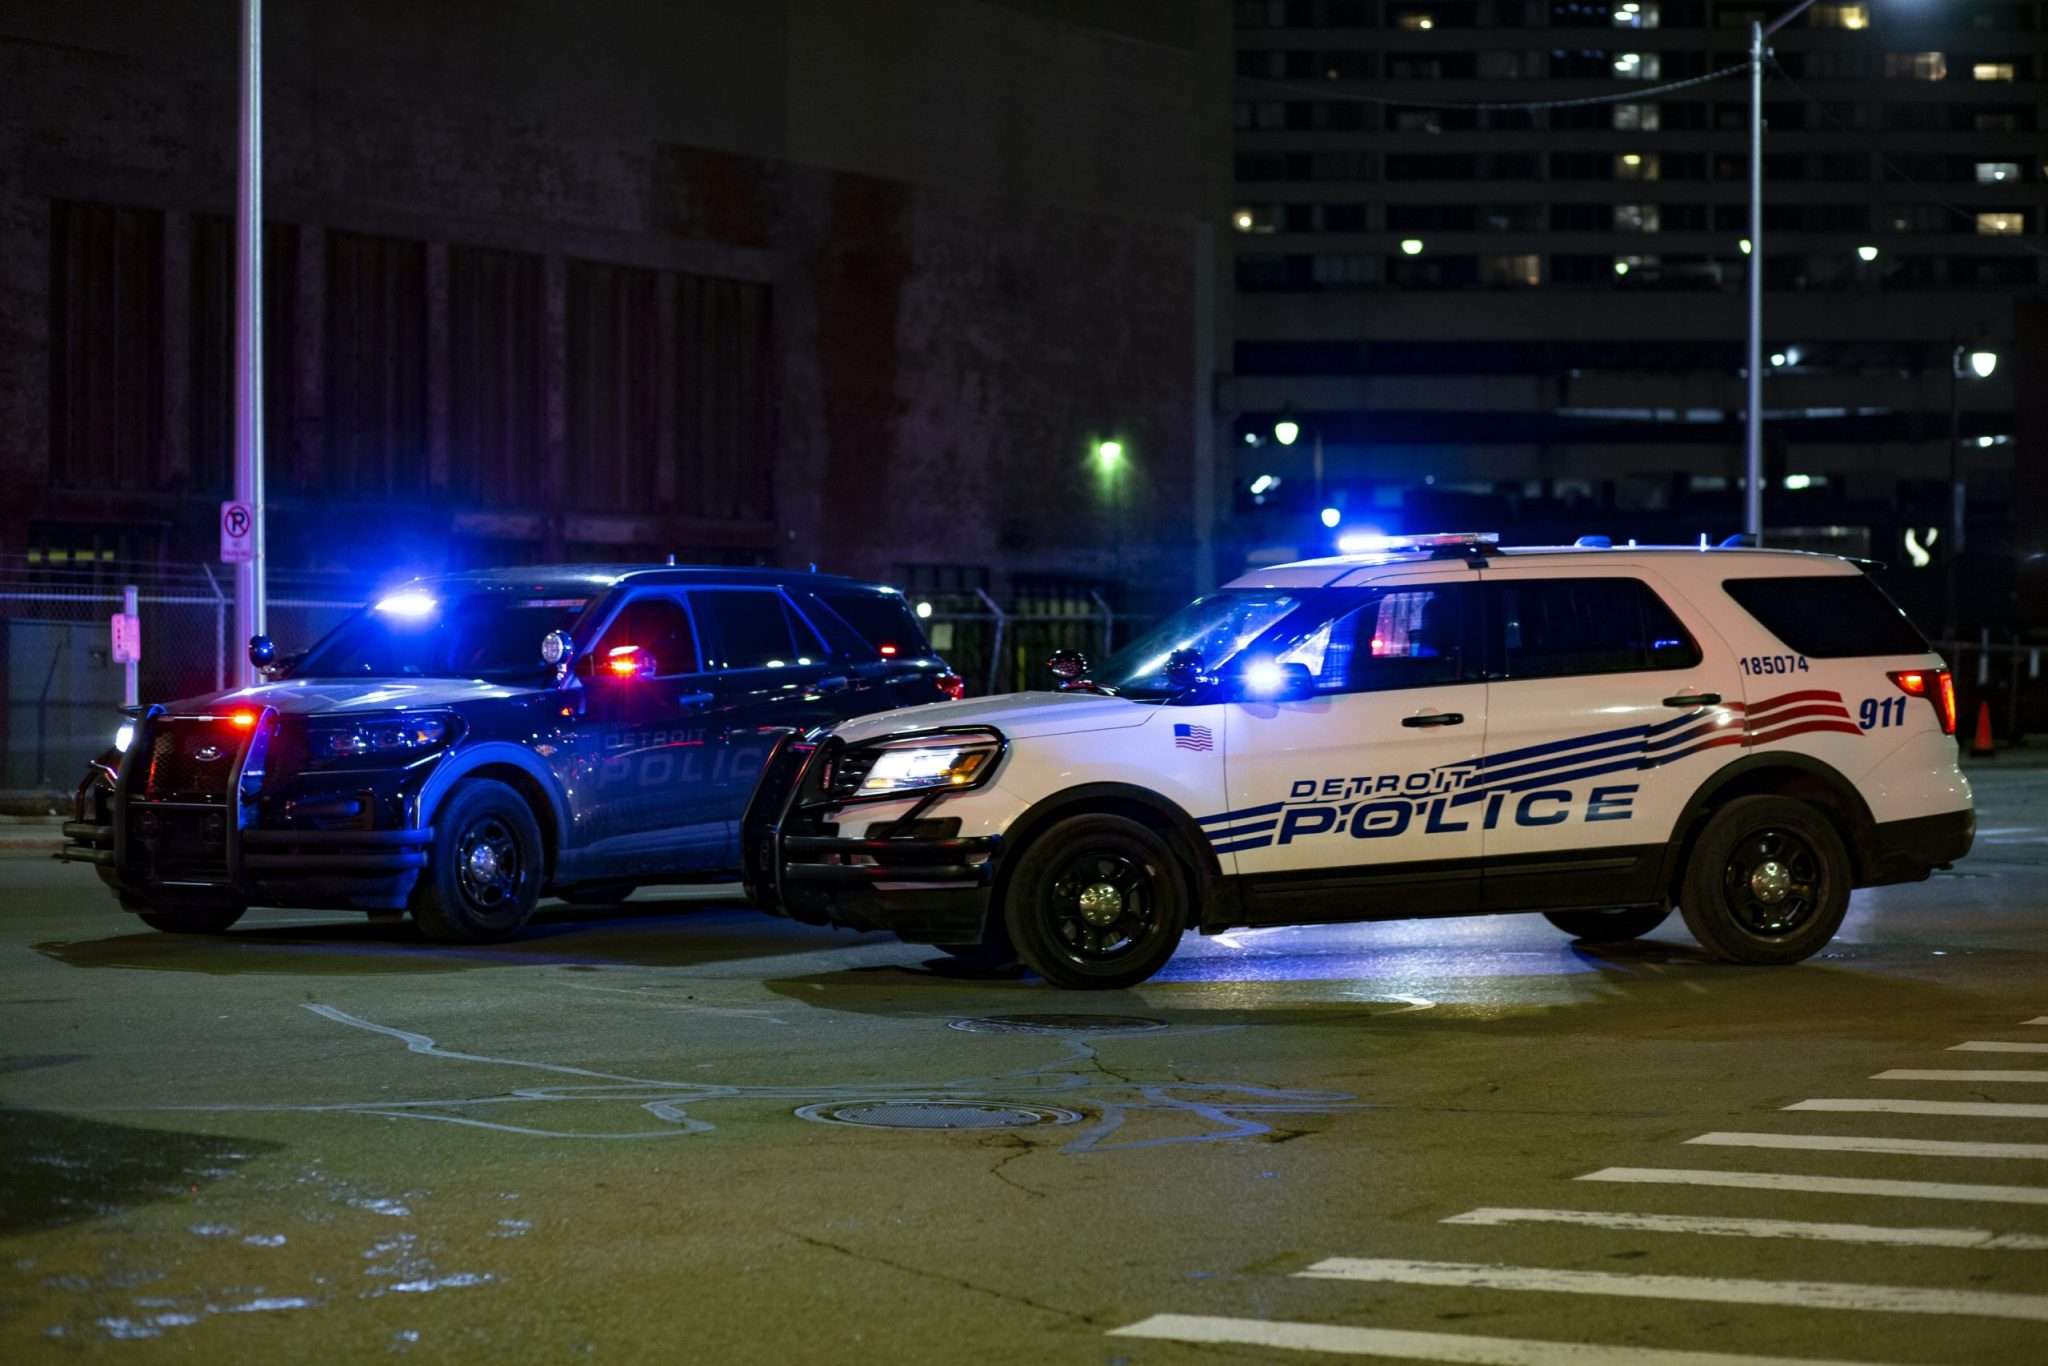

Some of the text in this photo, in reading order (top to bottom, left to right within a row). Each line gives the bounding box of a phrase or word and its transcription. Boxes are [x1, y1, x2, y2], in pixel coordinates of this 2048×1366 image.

[1740, 656, 1809, 675] 185074
[1859, 696, 1907, 729] 911
[597, 747, 763, 790] POLIC
[1290, 769, 1475, 798] DETROIT
[1277, 784, 1640, 845] POLICE
